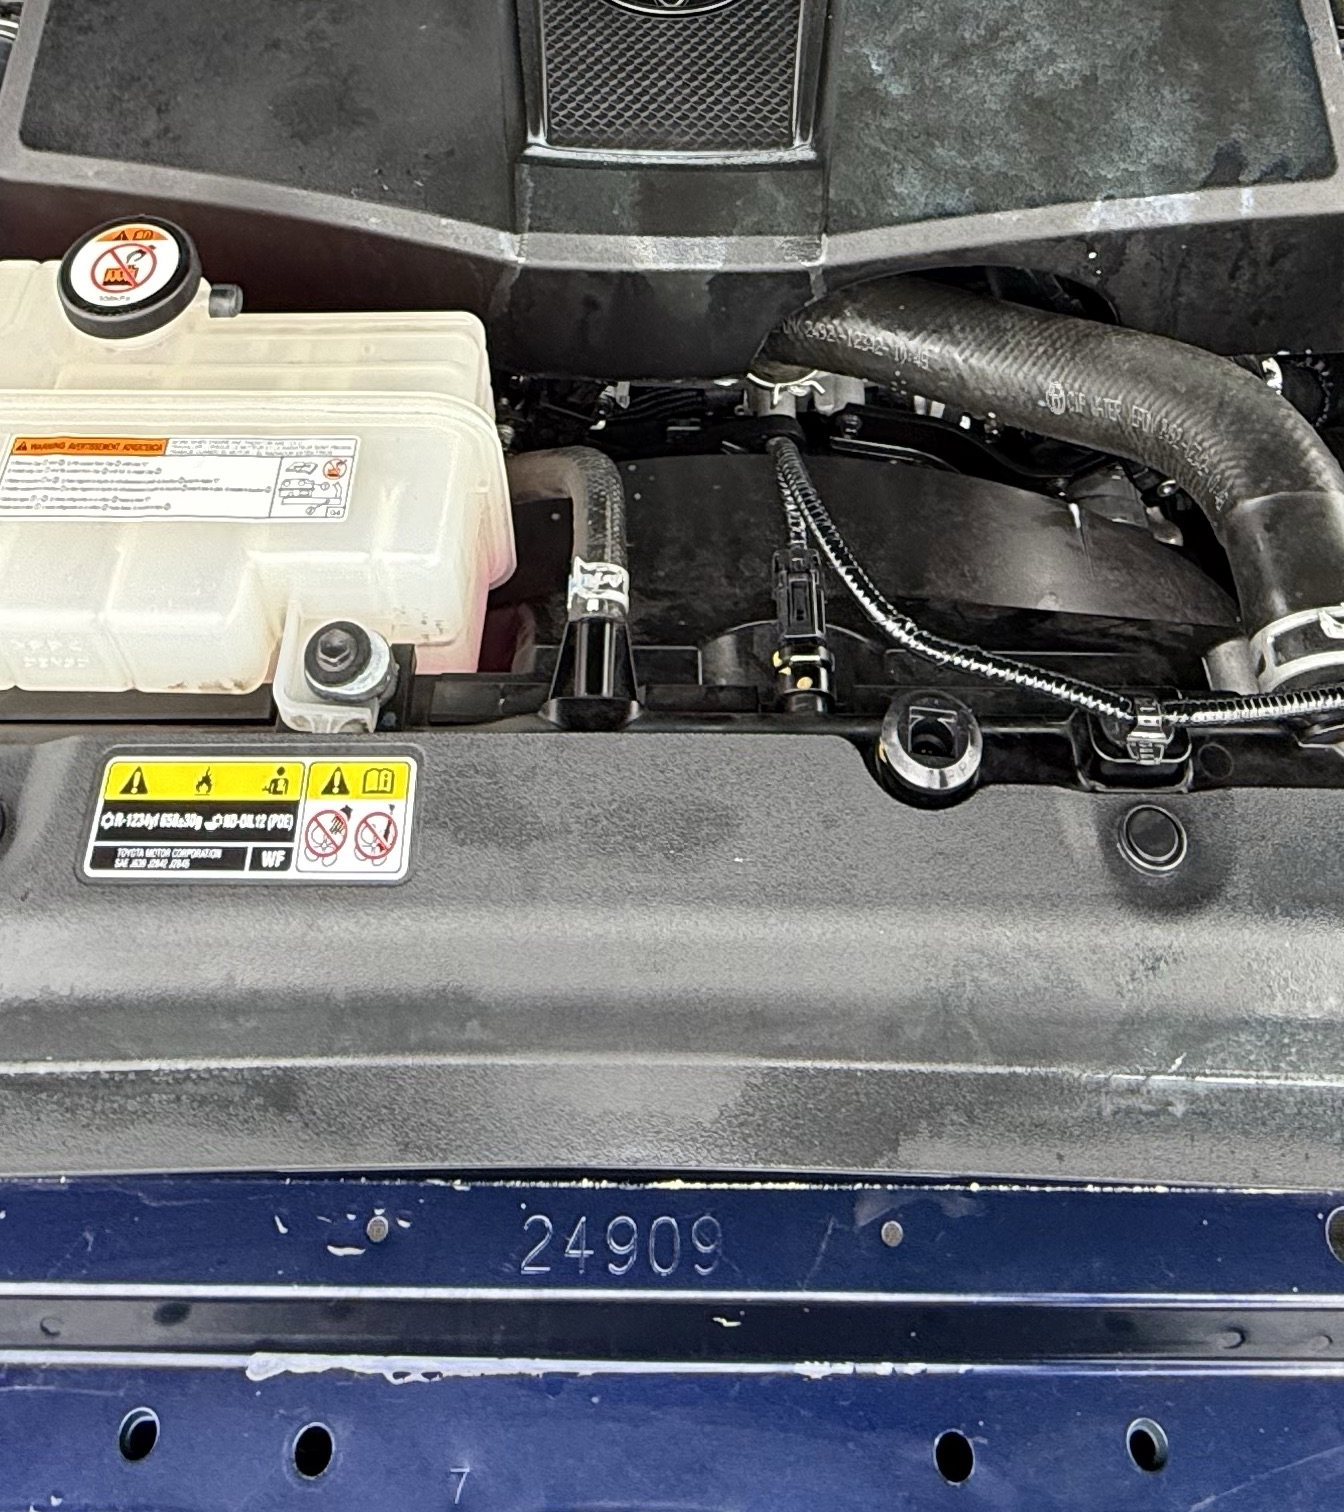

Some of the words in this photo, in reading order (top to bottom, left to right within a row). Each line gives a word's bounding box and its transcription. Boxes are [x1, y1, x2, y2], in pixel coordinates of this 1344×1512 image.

[117, 848, 144, 858] TOYOTA
[261, 850, 286, 869] WF
[520, 1214, 723, 1276] 24909
